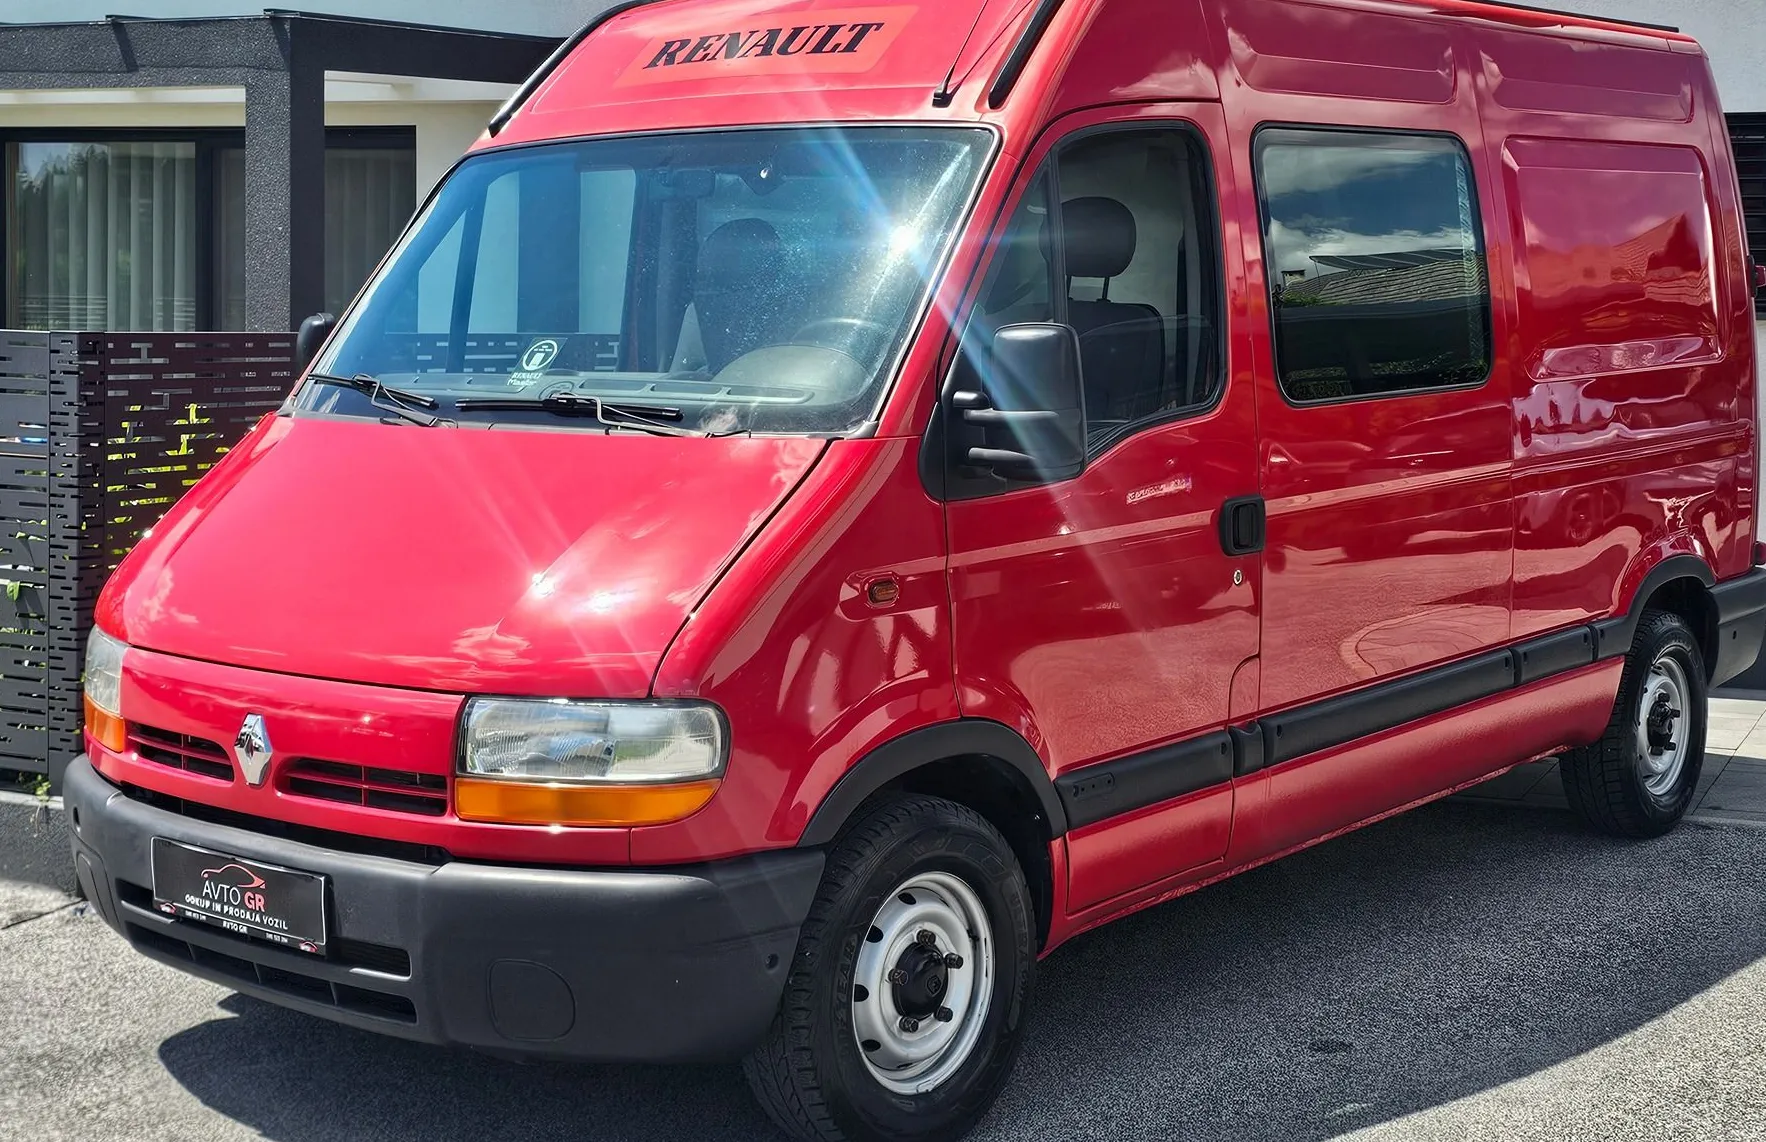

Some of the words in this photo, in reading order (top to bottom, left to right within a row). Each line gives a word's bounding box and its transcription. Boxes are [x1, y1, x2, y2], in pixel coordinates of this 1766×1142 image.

[643, 22, 884, 69] RENAULT
[202, 880, 241, 905] AVTO
[244, 891, 265, 912] GR
[212, 902, 221, 912] IN
[223, 905, 260, 923] PRODAJA
[262, 915, 288, 930] VOZIL
